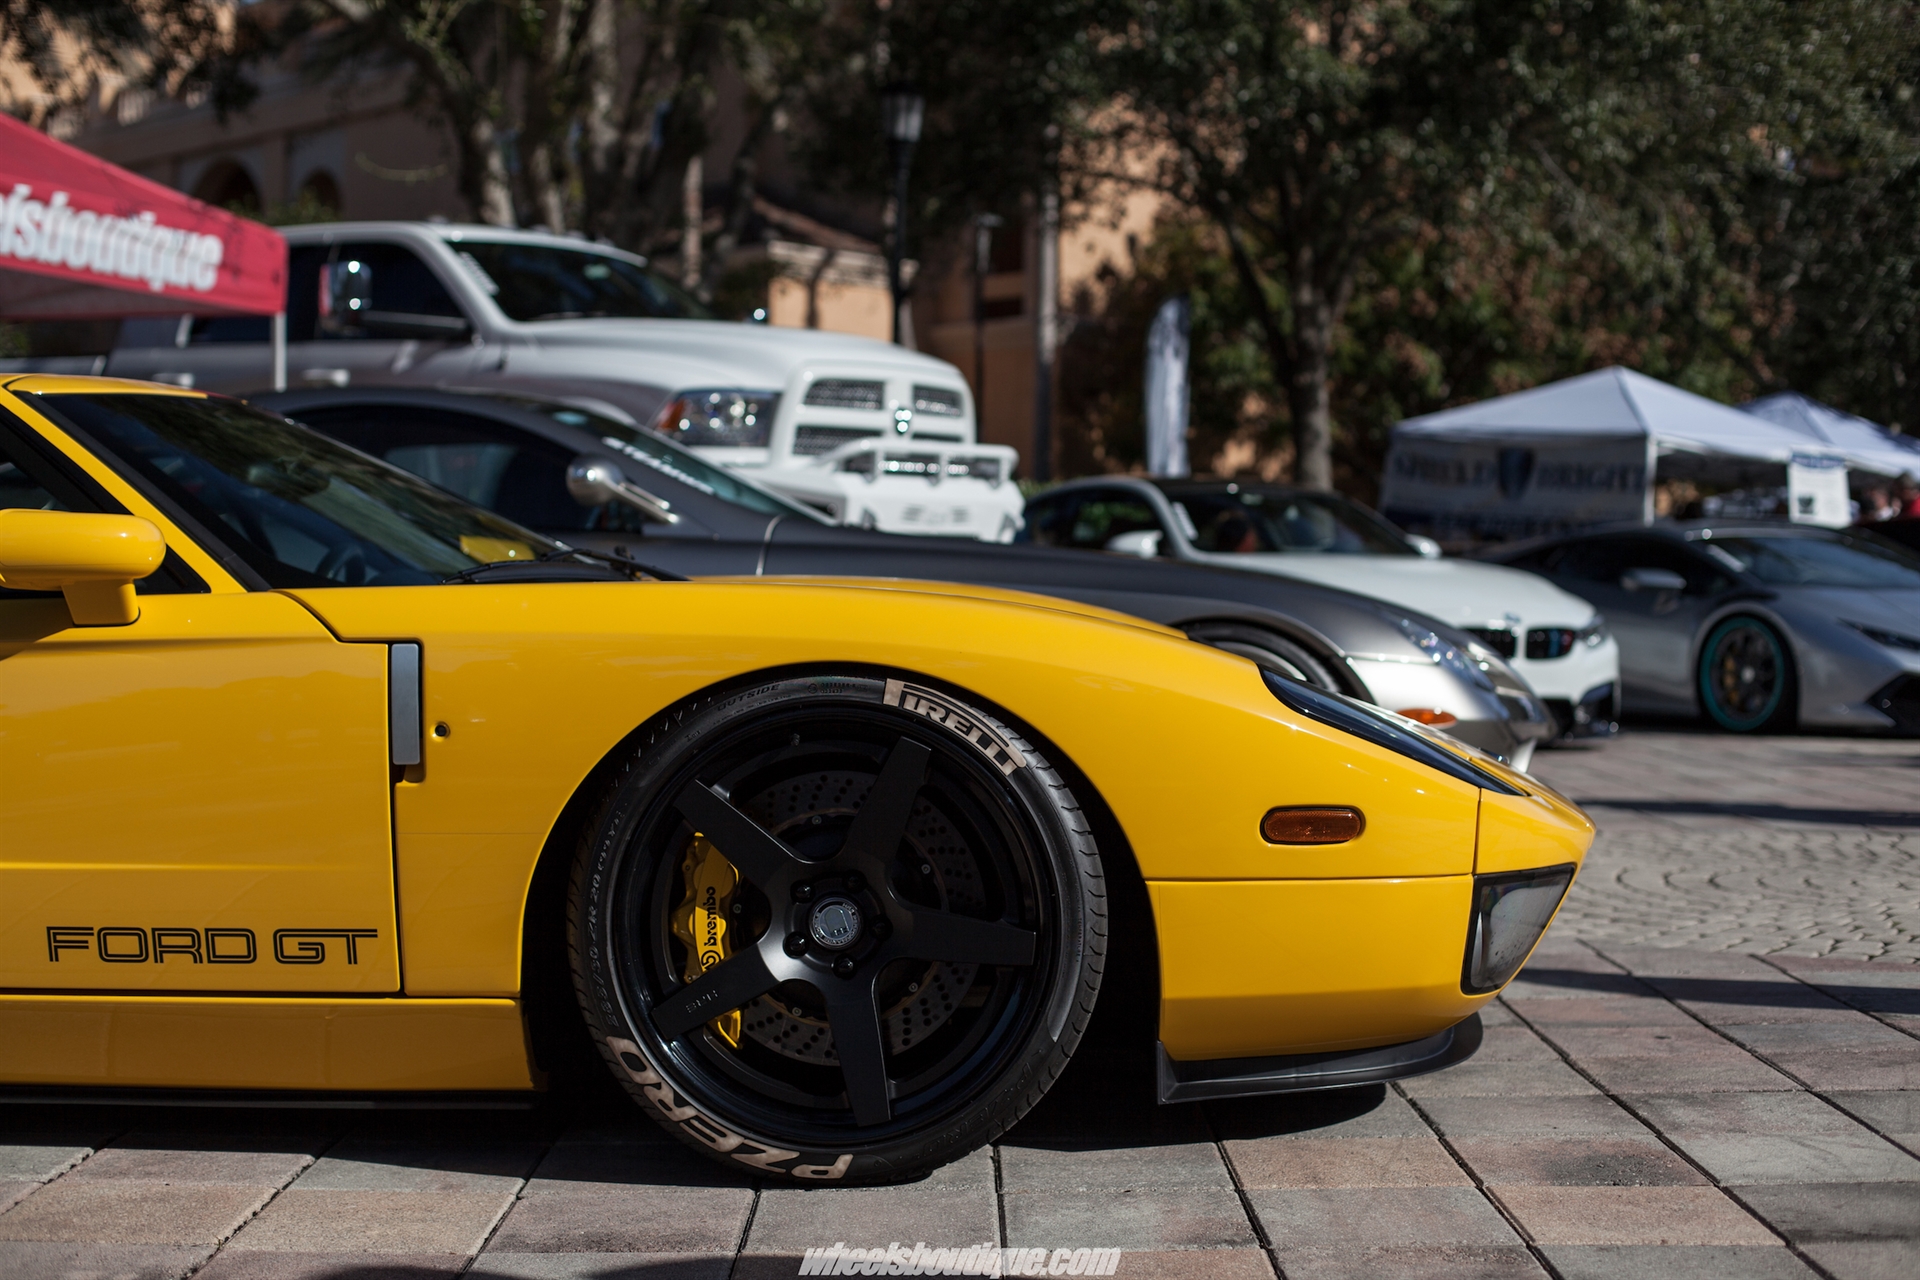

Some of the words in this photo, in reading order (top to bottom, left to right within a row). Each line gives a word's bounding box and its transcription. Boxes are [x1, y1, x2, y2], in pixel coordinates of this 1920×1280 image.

[0, 183, 224, 292] lsboutique
[717, 683, 781, 712] OUTSIDE
[883, 678, 1027, 776] PIRELLI
[46, 926, 257, 964] FORD
[273, 928, 378, 965] GT
[703, 885, 718, 947] brembo
